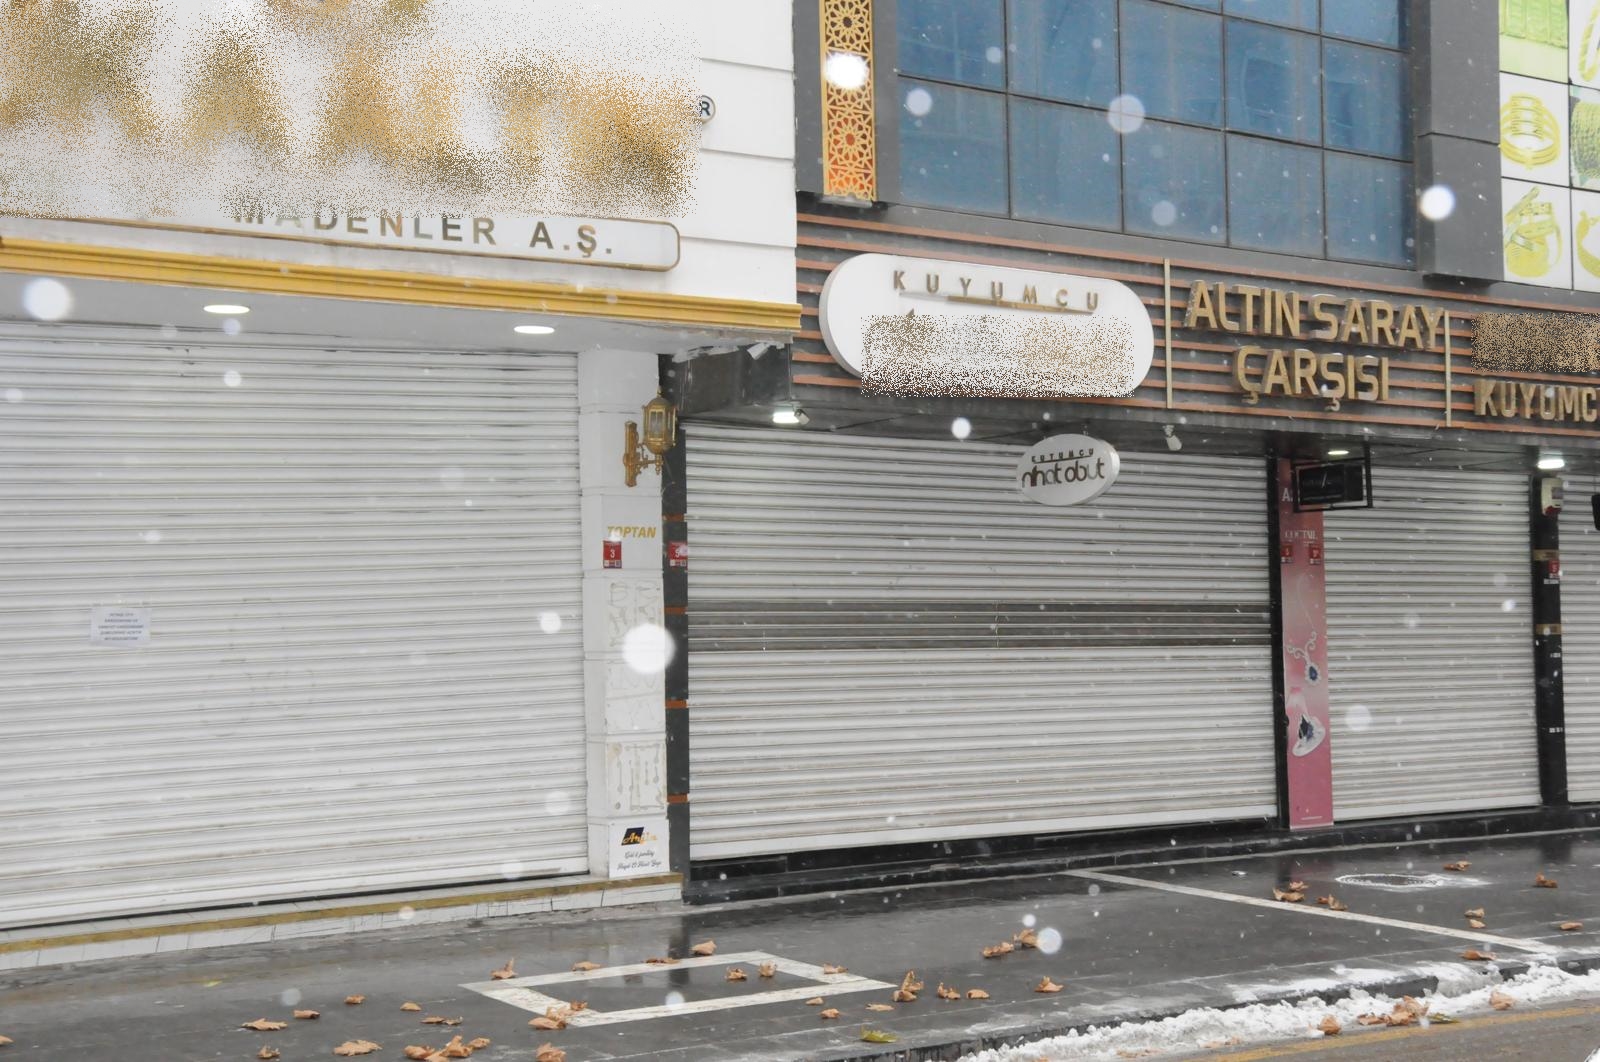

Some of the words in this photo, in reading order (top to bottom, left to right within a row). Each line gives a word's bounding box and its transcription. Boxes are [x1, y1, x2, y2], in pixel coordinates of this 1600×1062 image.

[234, 203, 496, 246] DENLER
[529, 221, 612, 258] A.Ş.
[893, 270, 1099, 311] KUYUMCU
[1184, 280, 1300, 337] ALTIN
[1309, 294, 1444, 349] SARAY
[1233, 345, 1389, 412] ÇARŞISI
[607, 526, 656, 538] TOPTAN
